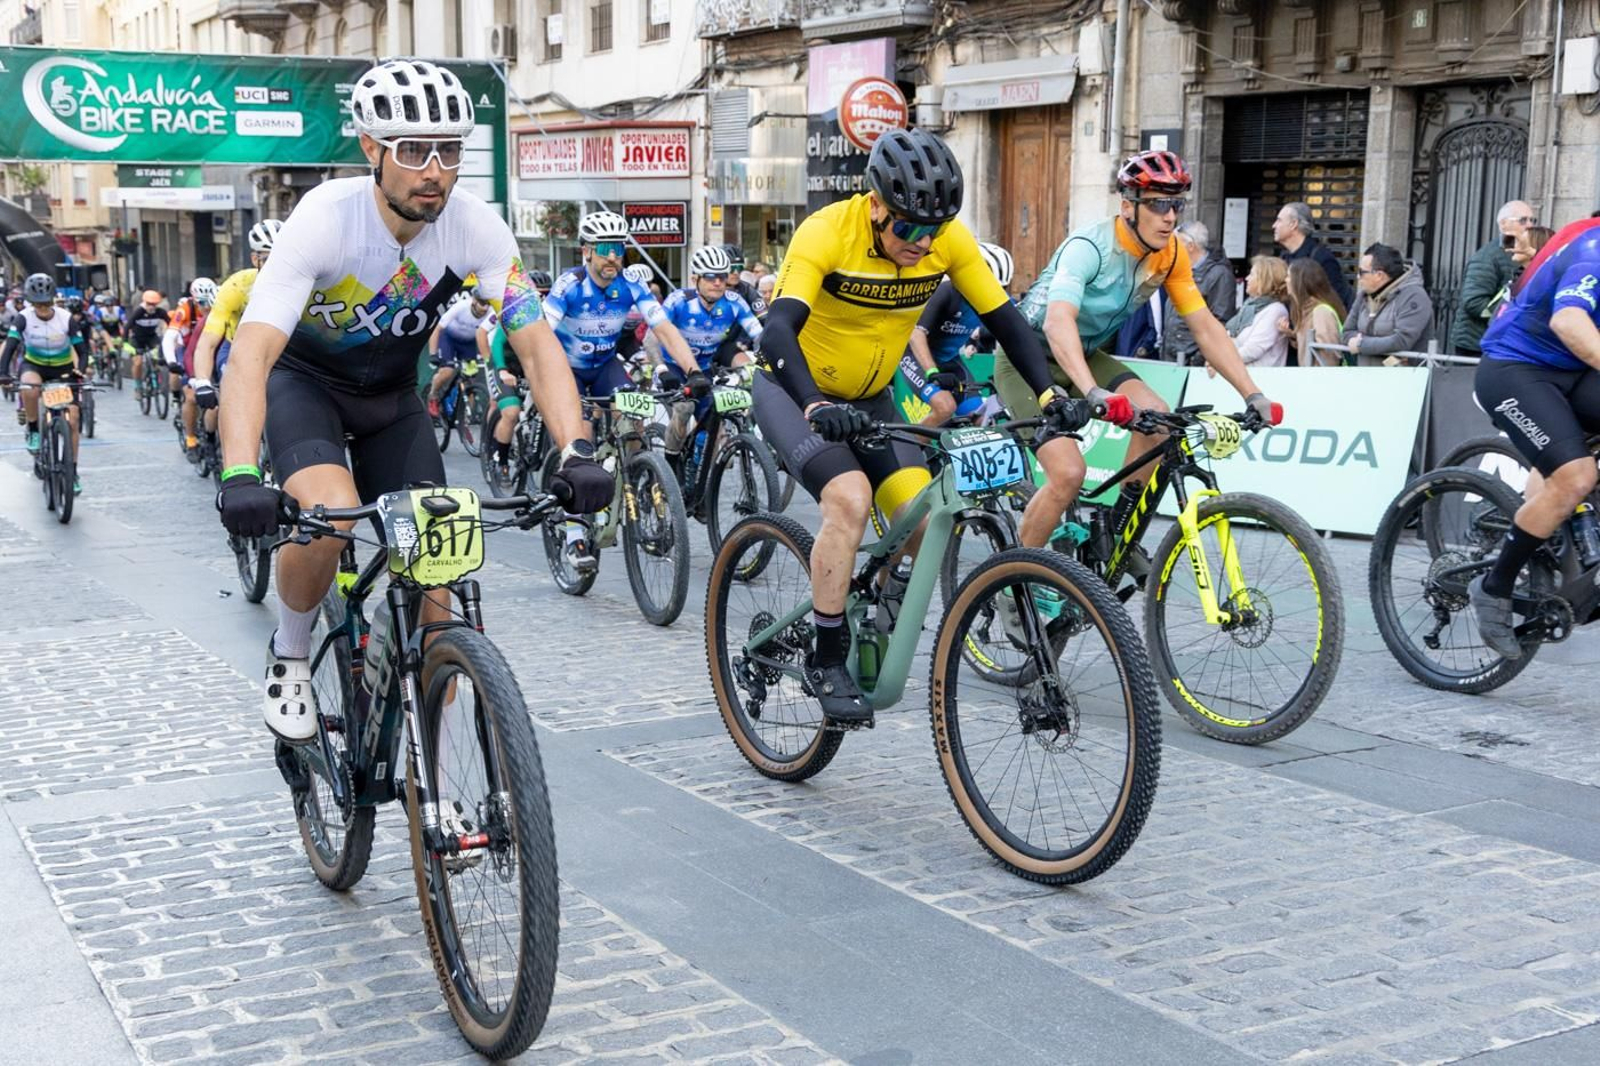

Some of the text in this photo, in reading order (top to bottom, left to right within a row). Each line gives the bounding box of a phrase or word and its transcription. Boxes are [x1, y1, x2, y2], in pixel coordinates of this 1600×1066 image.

[77, 71, 226, 110] Andalucía
[241, 90, 265, 100] UCI
[80, 106, 228, 134] BIKE RACE
[851, 103, 903, 121] Mahou
[243, 118, 296, 129] GARMIN
[621, 133, 687, 145] OPORTUNIDADES
[581, 137, 615, 172] JAVIER
[622, 146, 687, 163] JAVIER
[135, 168, 184, 177] STAGE 4
[521, 163, 578, 174] TODO EN TELAS
[622, 163, 645, 171] TODO
[661, 162, 688, 170] TELAS
[630, 217, 680, 232] JAVIER
[840, 278, 940, 299] CORRECAMINOS
[621, 392, 651, 411] 1065
[720, 391, 747, 407] 1064
[1194, 427, 1379, 468] KODA
[426, 515, 476, 558] 617
[427, 558, 463, 567] CARVALHO
[934, 678, 950, 755] MAXXIS
[425, 918, 455, 998] PHANTOM
